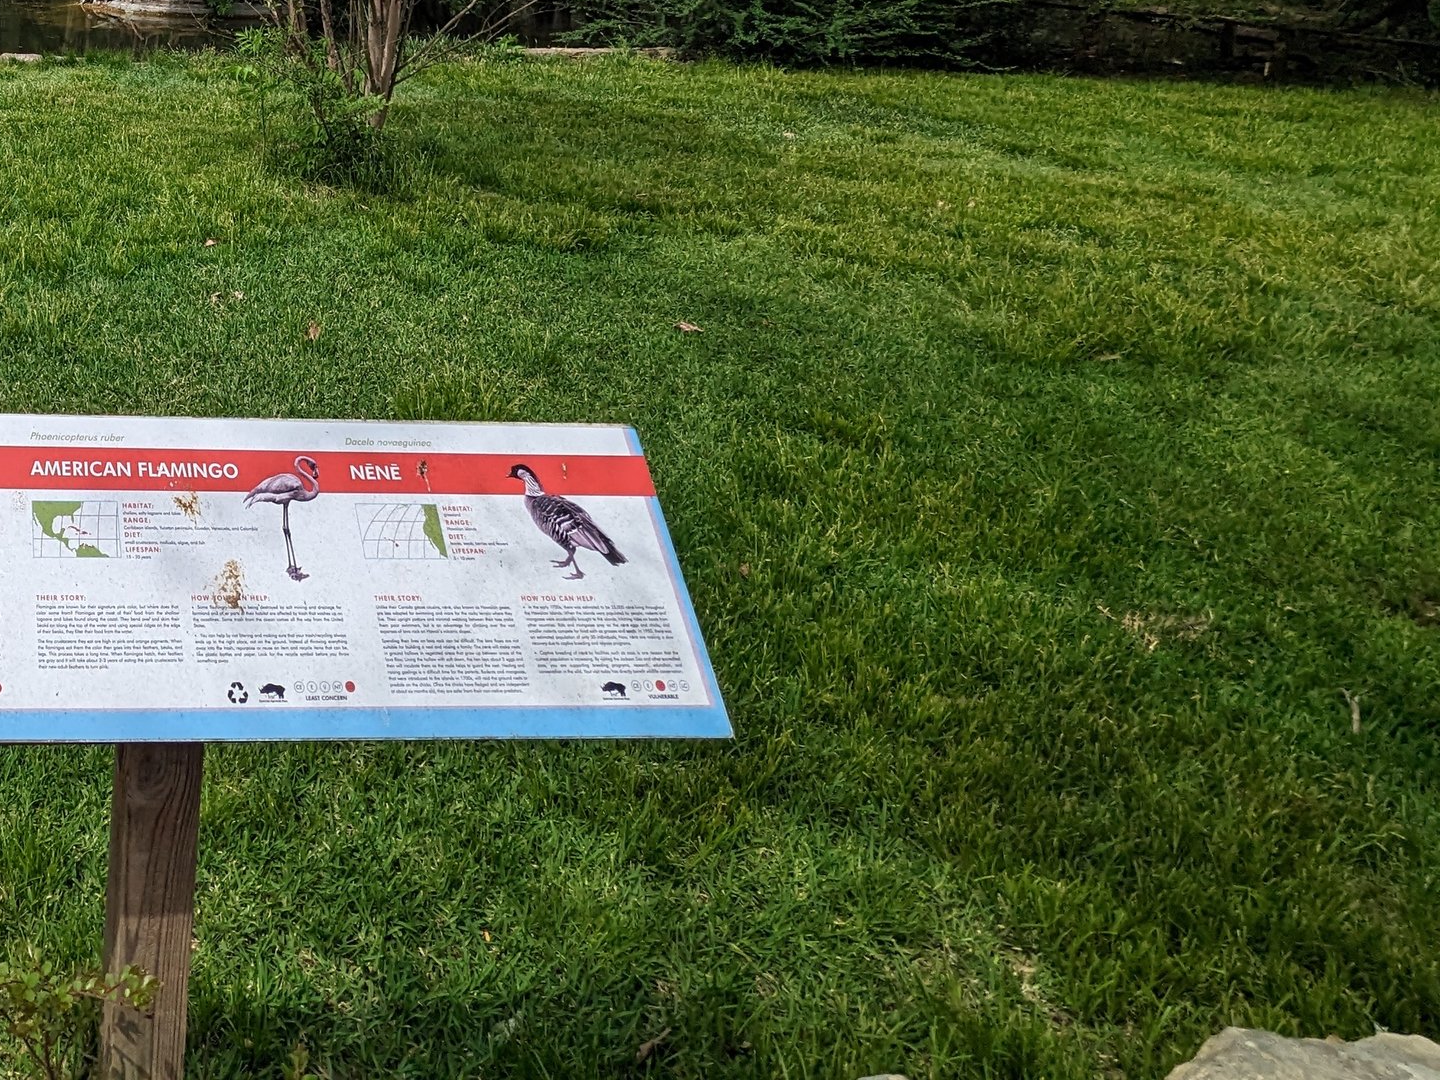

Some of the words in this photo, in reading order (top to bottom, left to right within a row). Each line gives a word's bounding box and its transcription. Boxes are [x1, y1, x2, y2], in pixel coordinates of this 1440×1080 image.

[30, 432, 98, 444] Phoenicopterus
[100, 433, 125, 443] ruber
[345, 438, 374, 447] Dacelo
[30, 460, 131, 478] AMERICAN
[138, 462, 238, 479] FLAMINGO
[349, 462, 402, 481] NĒNĒ
